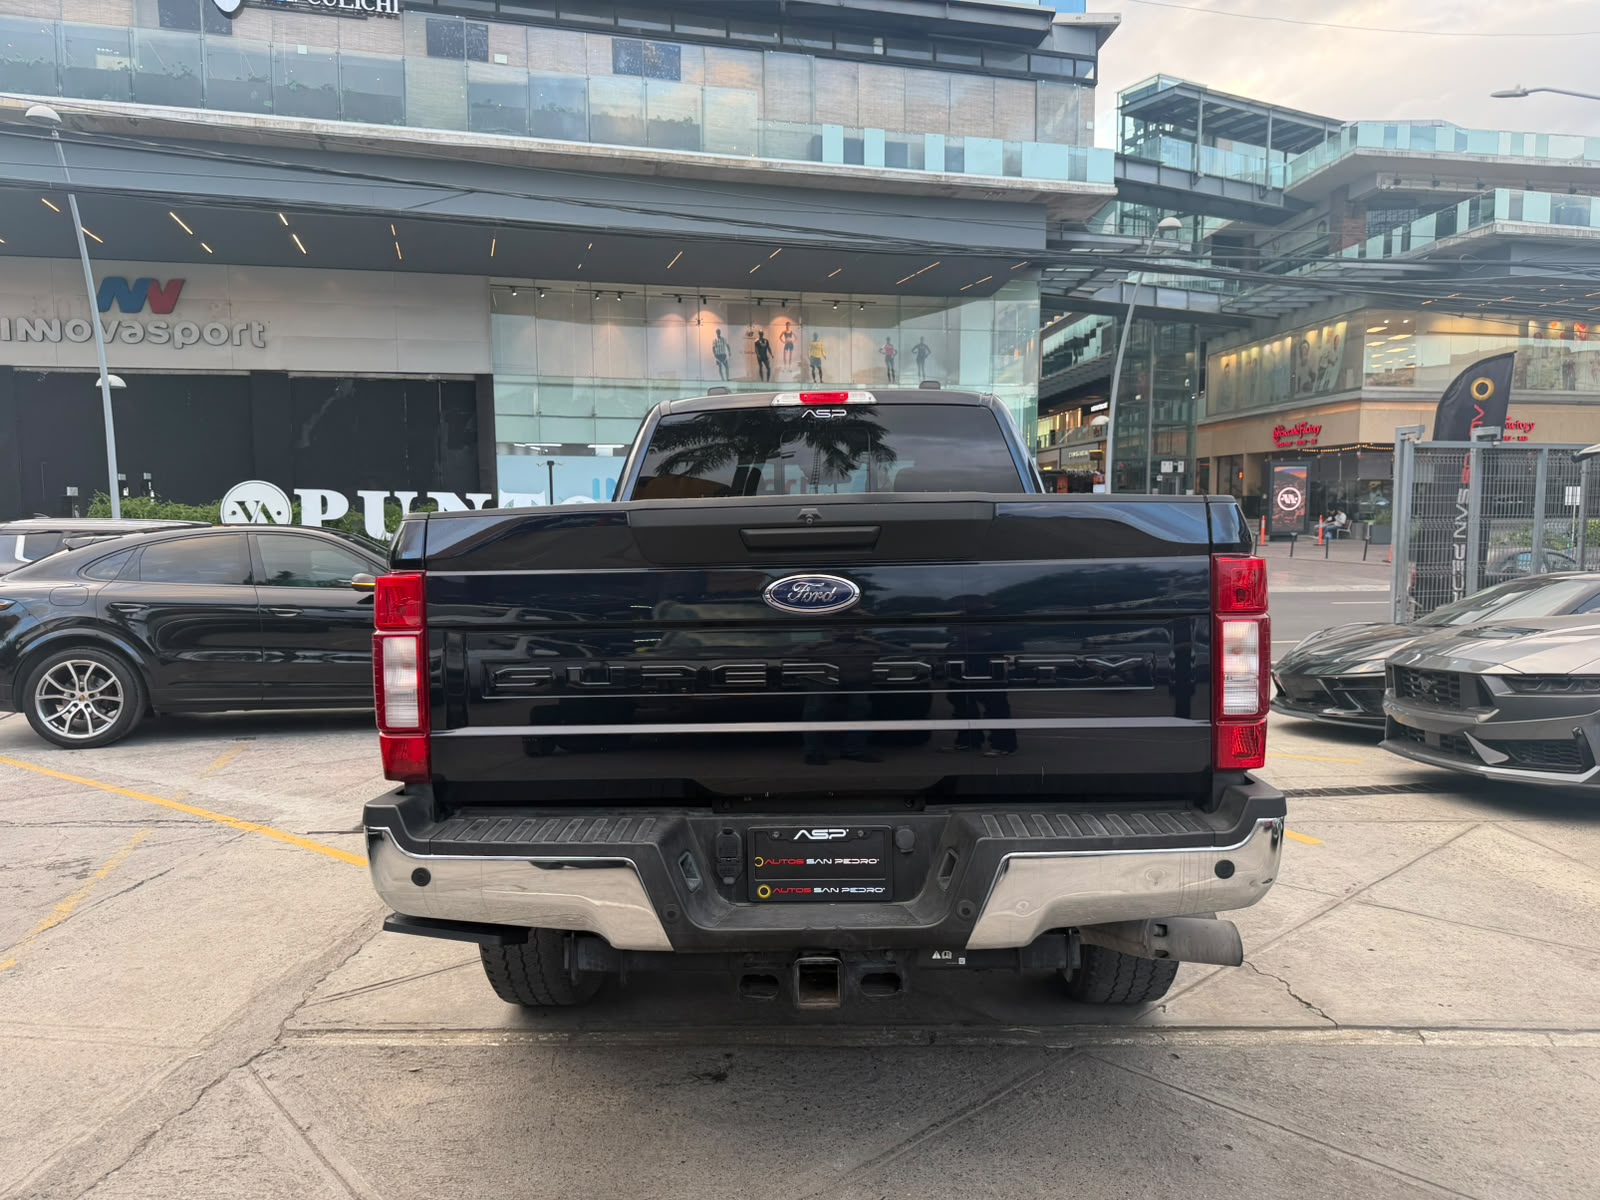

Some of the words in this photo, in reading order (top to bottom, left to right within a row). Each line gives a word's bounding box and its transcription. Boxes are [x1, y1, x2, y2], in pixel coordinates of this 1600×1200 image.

[308, 0, 400, 14] LICHI
[801, 409, 847, 419] ASP
[1452, 543, 1466, 602] PEDR
[787, 581, 837, 603] Ford
[494, 661, 840, 689] SUPER
[872, 656, 1144, 684] DUTY
[793, 829, 849, 840] ASP
[765, 858, 805, 866] AUTOS
